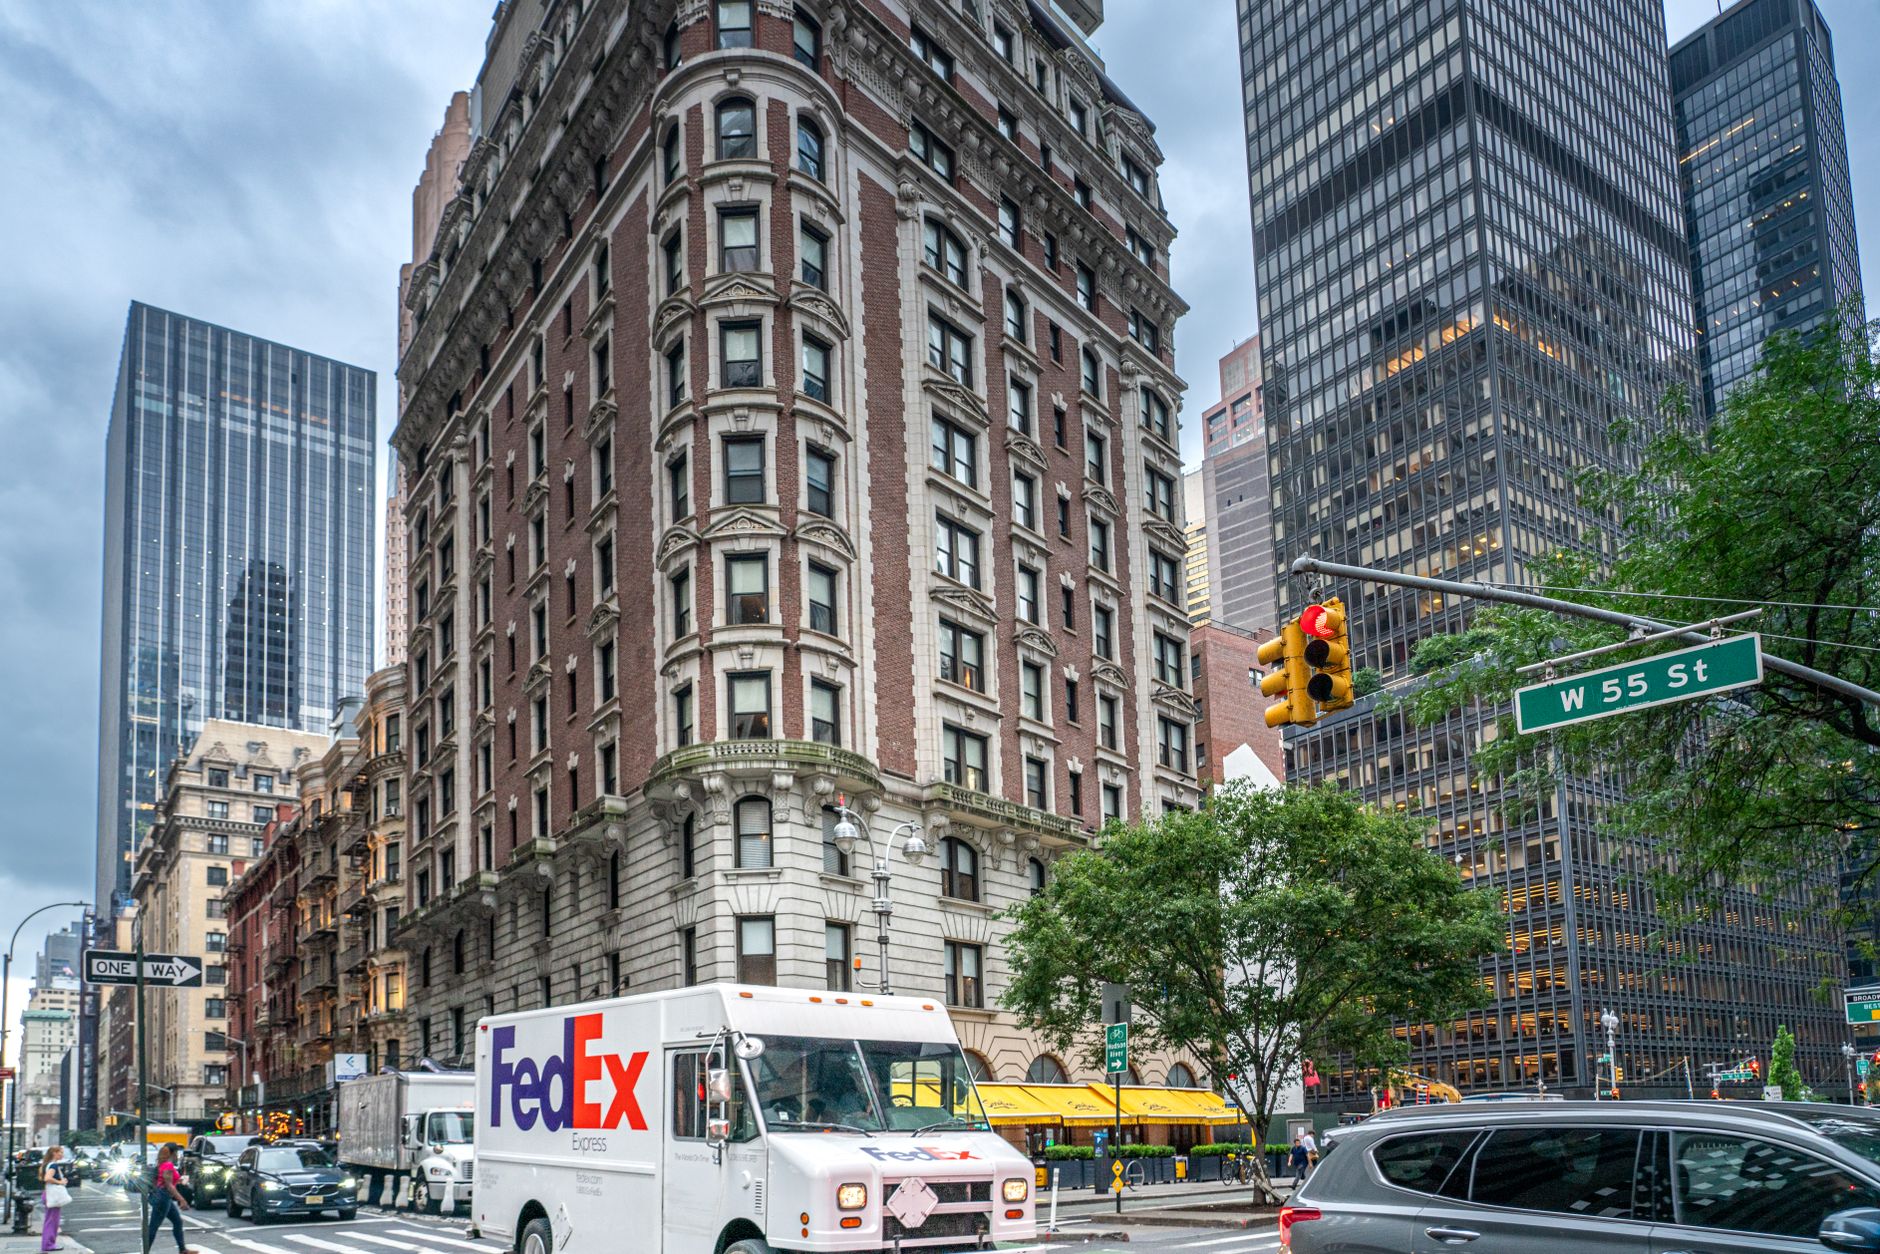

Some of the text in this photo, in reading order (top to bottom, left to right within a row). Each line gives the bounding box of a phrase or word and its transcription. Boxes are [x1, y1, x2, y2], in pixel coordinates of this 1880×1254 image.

[1560, 659, 1708, 713] W 55 St
[96, 961, 188, 977] ONE WAY
[491, 1013, 649, 1132] FedEx
[572, 1132, 607, 1155] Express
[859, 1146, 983, 1161] FedEx
